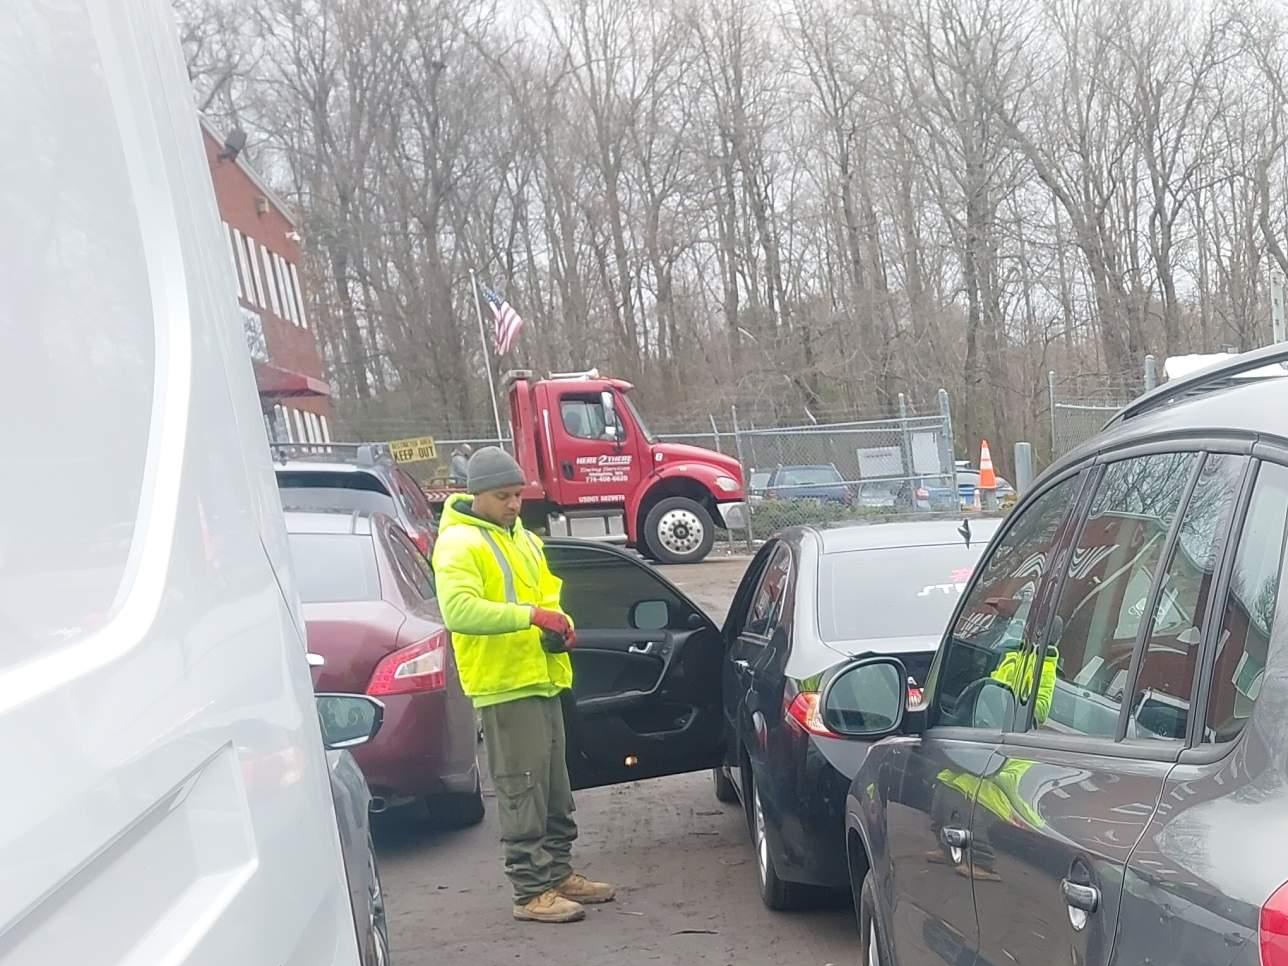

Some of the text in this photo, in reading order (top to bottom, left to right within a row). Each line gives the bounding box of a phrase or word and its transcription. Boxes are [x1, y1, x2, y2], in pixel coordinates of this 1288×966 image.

[393, 446, 434, 461] KEEP OUT
[576, 456, 597, 464] HERE
